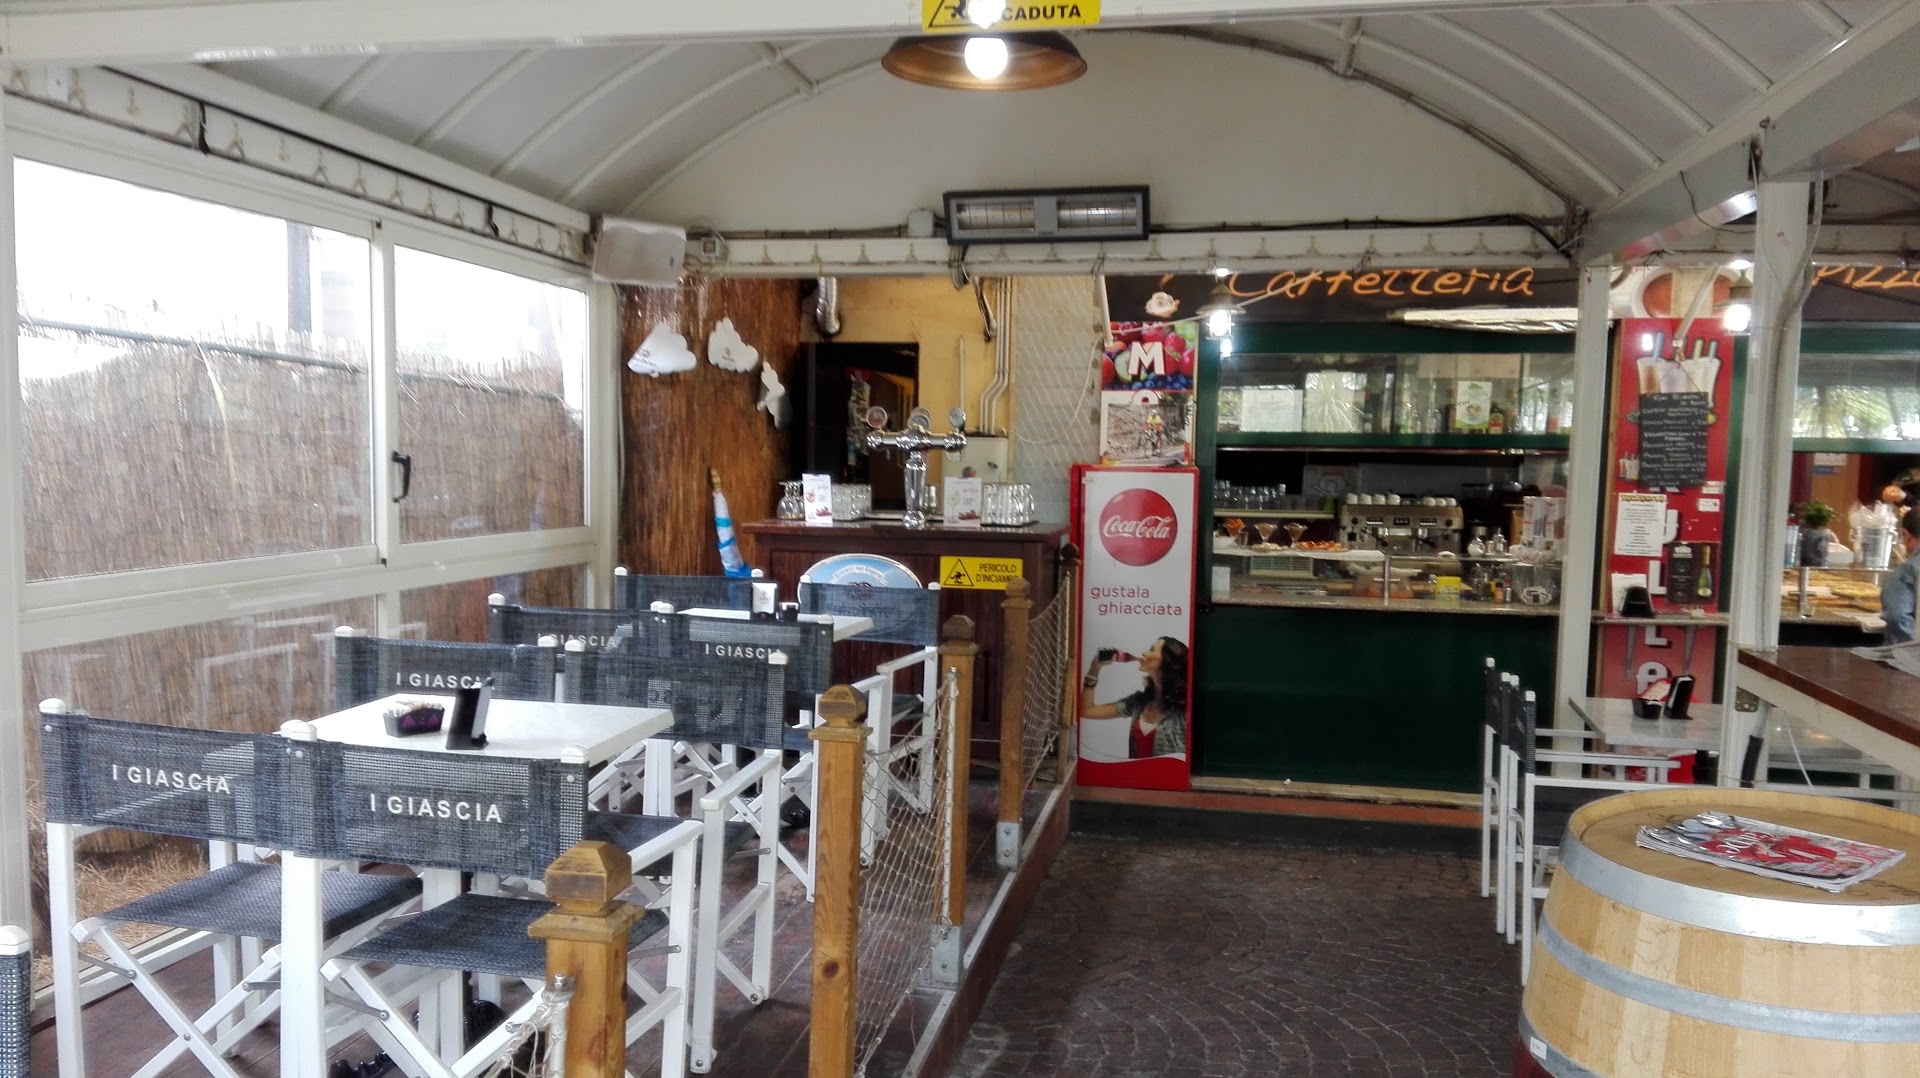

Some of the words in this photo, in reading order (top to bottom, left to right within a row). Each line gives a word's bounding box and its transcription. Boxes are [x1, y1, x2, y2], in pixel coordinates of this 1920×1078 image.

[1001, 5, 1081, 21] CADUTA
[1811, 265, 1920, 289] PIZZ
[1103, 515, 1174, 539] Coca-Cola
[979, 563, 1017, 573] PERICOLO
[976, 573, 1019, 583] D'INCIAMP
[1090, 585, 1150, 599] gustala
[1098, 601, 1182, 616] ghiacciata
[549, 633, 618, 648] IASCIA
[705, 643, 709, 655] I
[715, 645, 782, 660] GIASCI
[396, 672, 401, 686] I
[409, 673, 495, 690] GIASC
[112, 764, 118, 781] I
[127, 767, 231, 795] GIASCIA
[370, 793, 376, 812] I
[387, 796, 502, 823] GIASCIA
